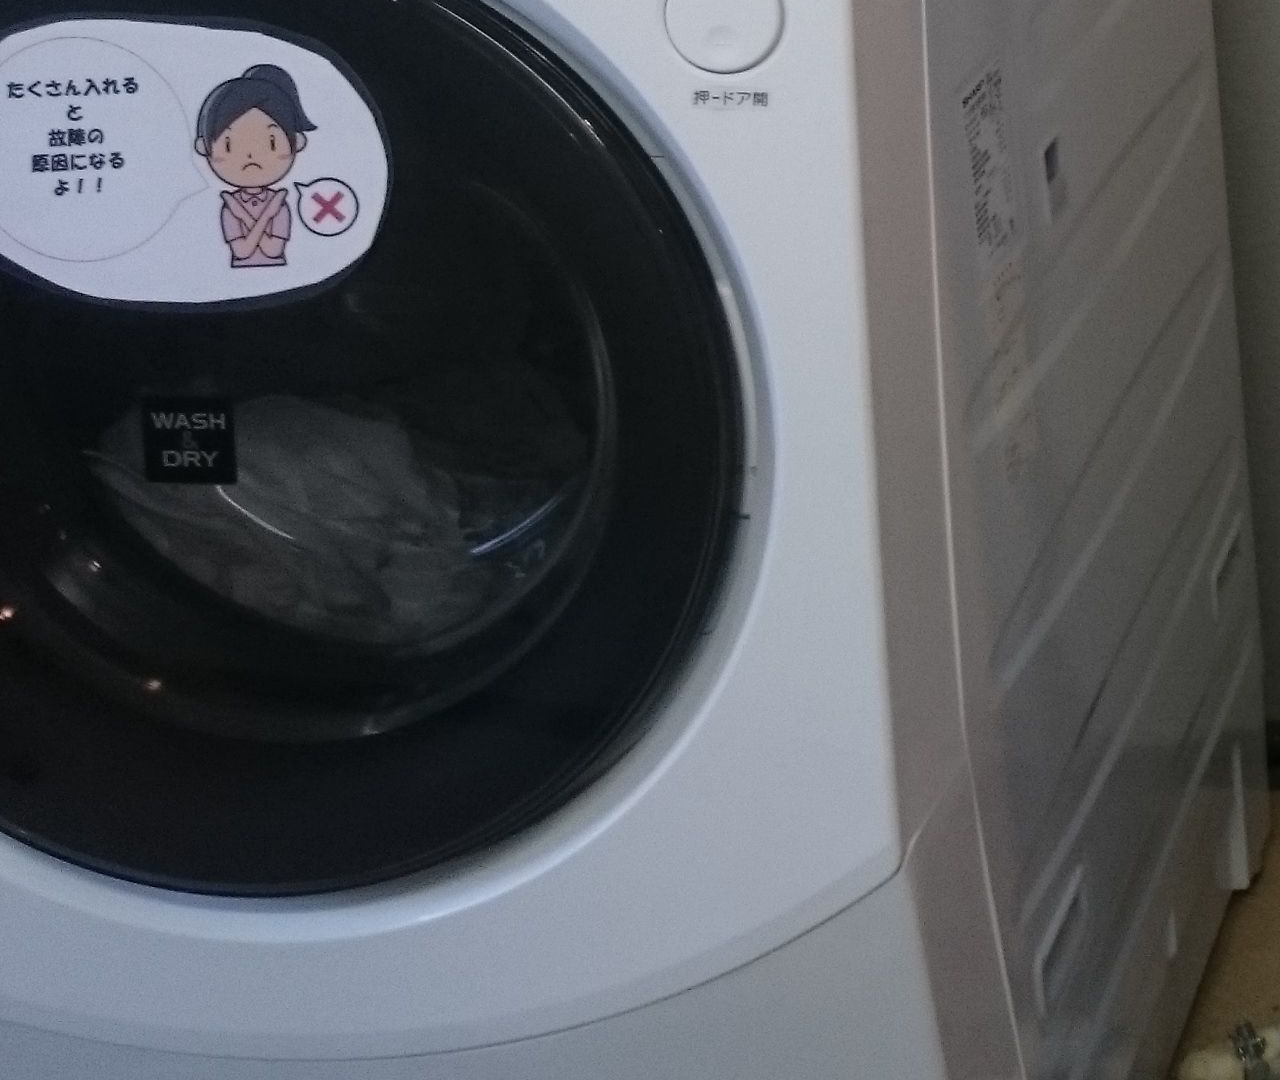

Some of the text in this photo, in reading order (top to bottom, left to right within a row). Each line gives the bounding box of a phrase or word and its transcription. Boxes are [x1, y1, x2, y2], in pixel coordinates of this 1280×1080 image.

[7, 77, 139, 98] たくさん入れる
[67, 104, 83, 121] と
[48, 128, 104, 146] 故障の
[32, 153, 125, 172] 原因になる
[150, 412, 226, 429] WASH
[162, 450, 219, 467] DRY
